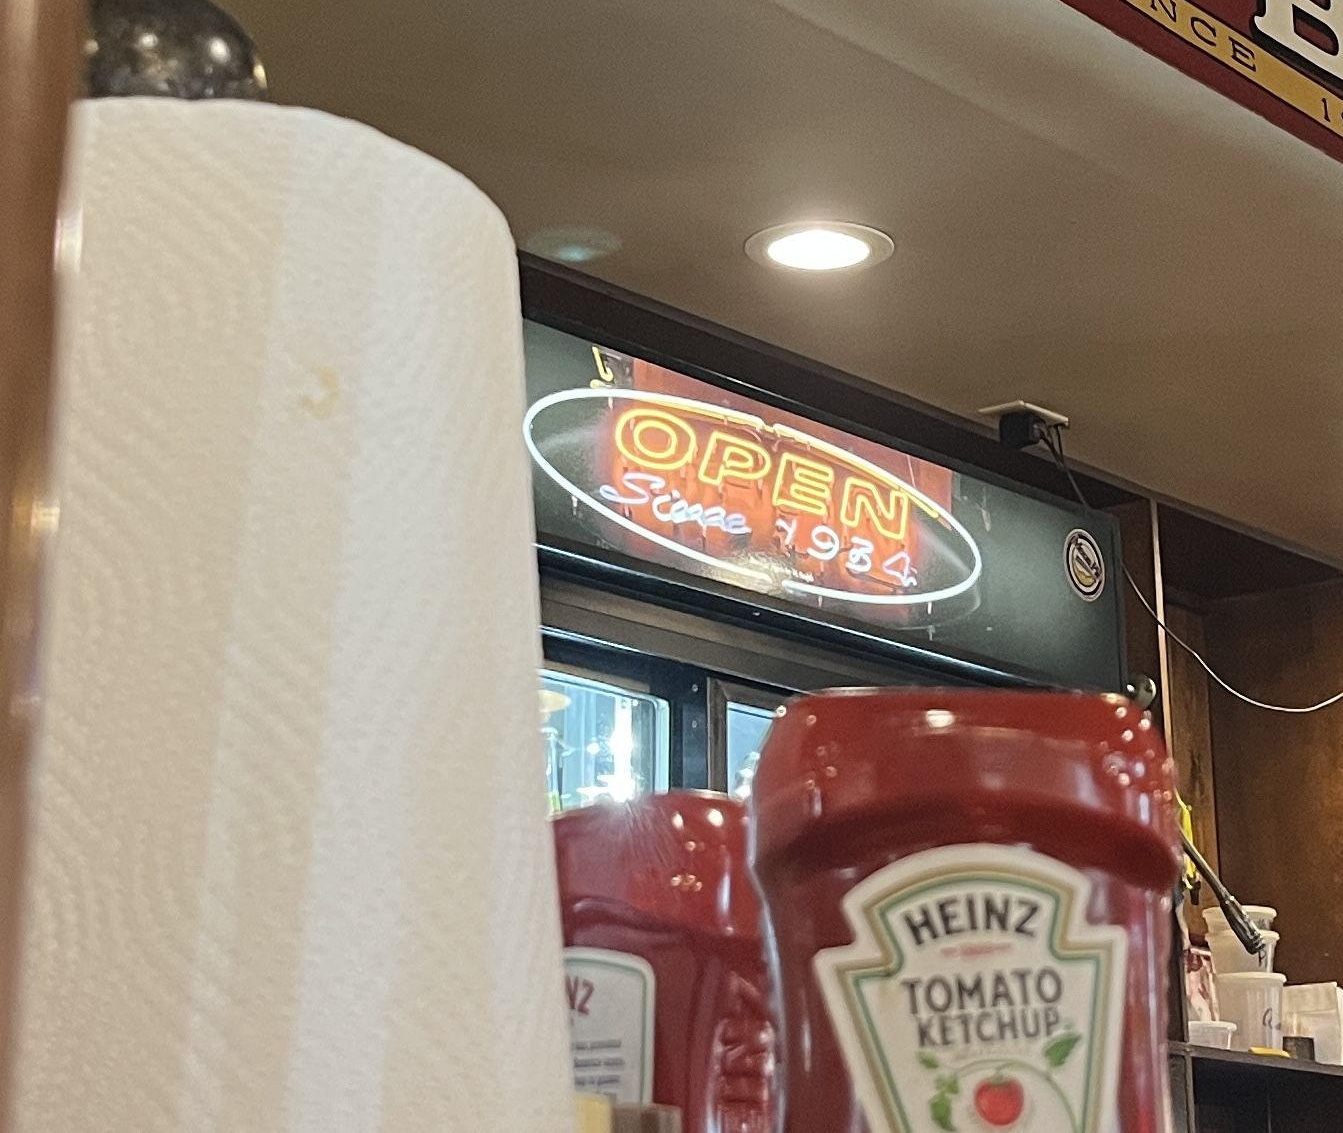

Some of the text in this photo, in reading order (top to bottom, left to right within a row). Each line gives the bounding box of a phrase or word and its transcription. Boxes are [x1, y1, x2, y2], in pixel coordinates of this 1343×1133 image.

[614, 407, 913, 541] OPEN
[599, 472, 752, 535] Since
[904, 892, 1041, 947] HEINZ
[901, 967, 1064, 1015] TOMATO
[916, 1006, 1061, 1049] KETCHUP
